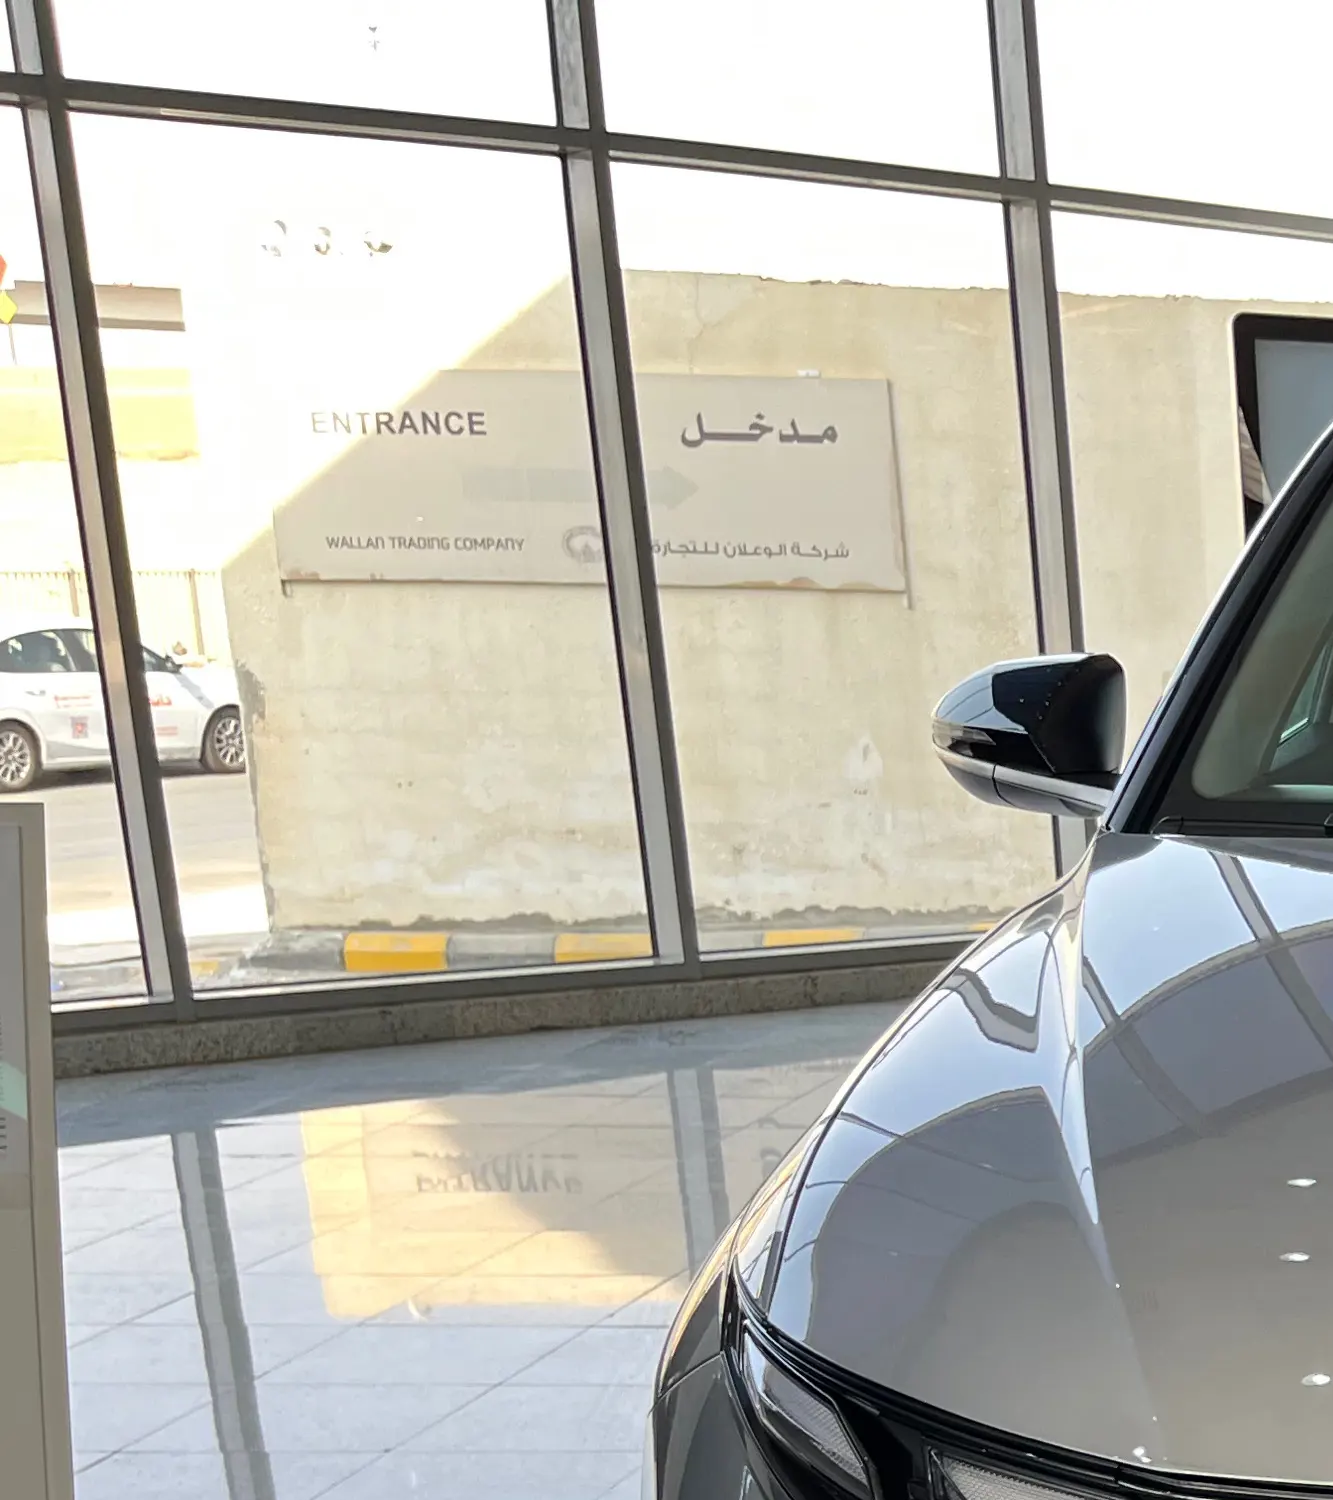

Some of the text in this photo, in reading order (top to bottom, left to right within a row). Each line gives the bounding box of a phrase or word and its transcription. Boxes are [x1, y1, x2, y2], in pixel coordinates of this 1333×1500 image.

[311, 411, 487, 436] ENTRANCE
[681, 411, 838, 448] مدخل
[389, 537, 450, 550] TRADING
[454, 537, 524, 551] COMPANY
[652, 540, 849, 560] شركة الوعلان للتجارة
